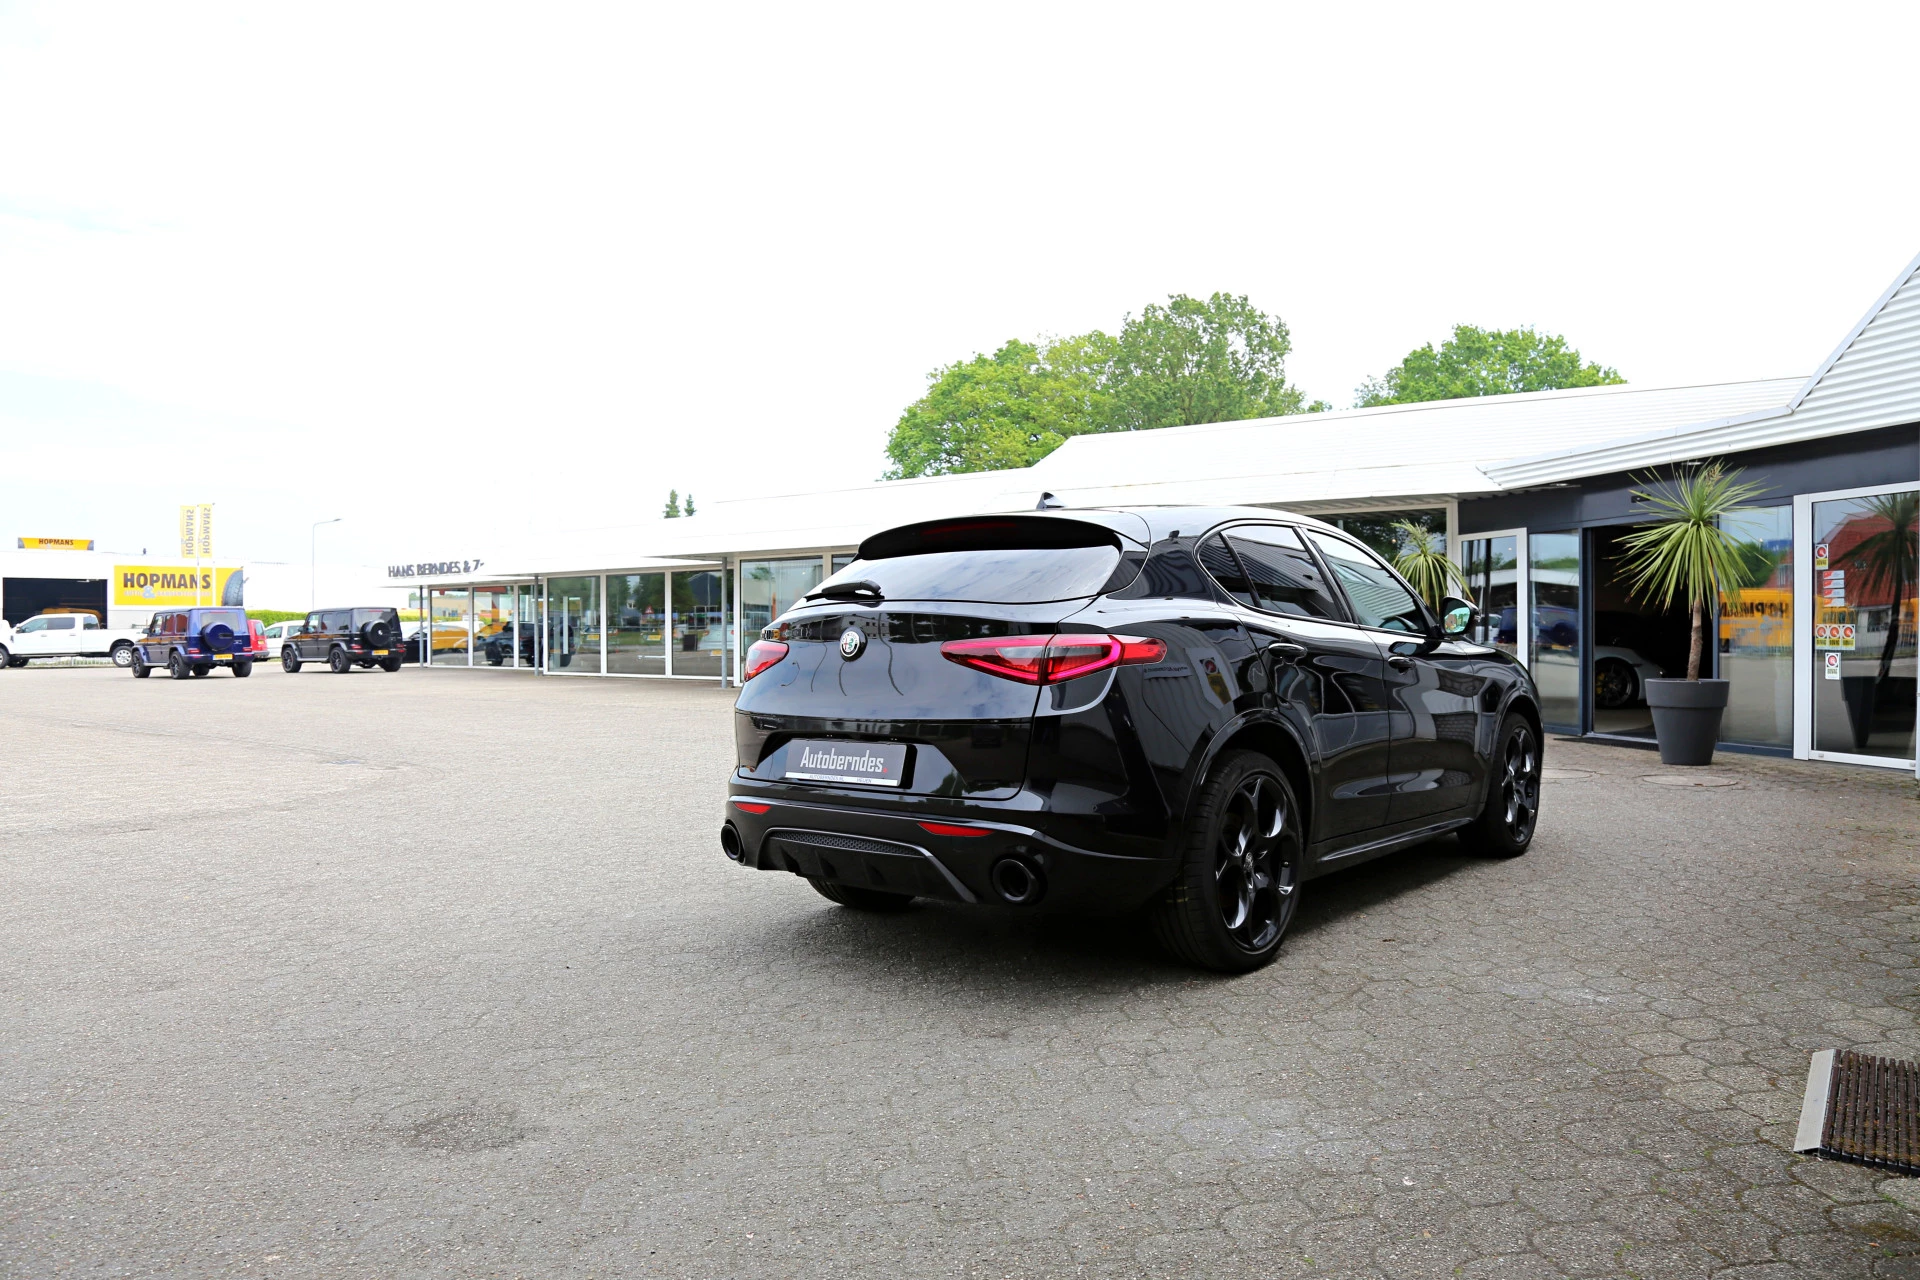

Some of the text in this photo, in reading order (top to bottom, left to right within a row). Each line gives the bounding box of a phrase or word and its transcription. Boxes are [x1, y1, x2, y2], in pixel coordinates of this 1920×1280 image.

[38, 538, 74, 546] HOPMANS
[388, 565, 415, 577] HANS
[416, 561, 461, 576] BERNDES
[123, 572, 211, 589] HOPMANS
